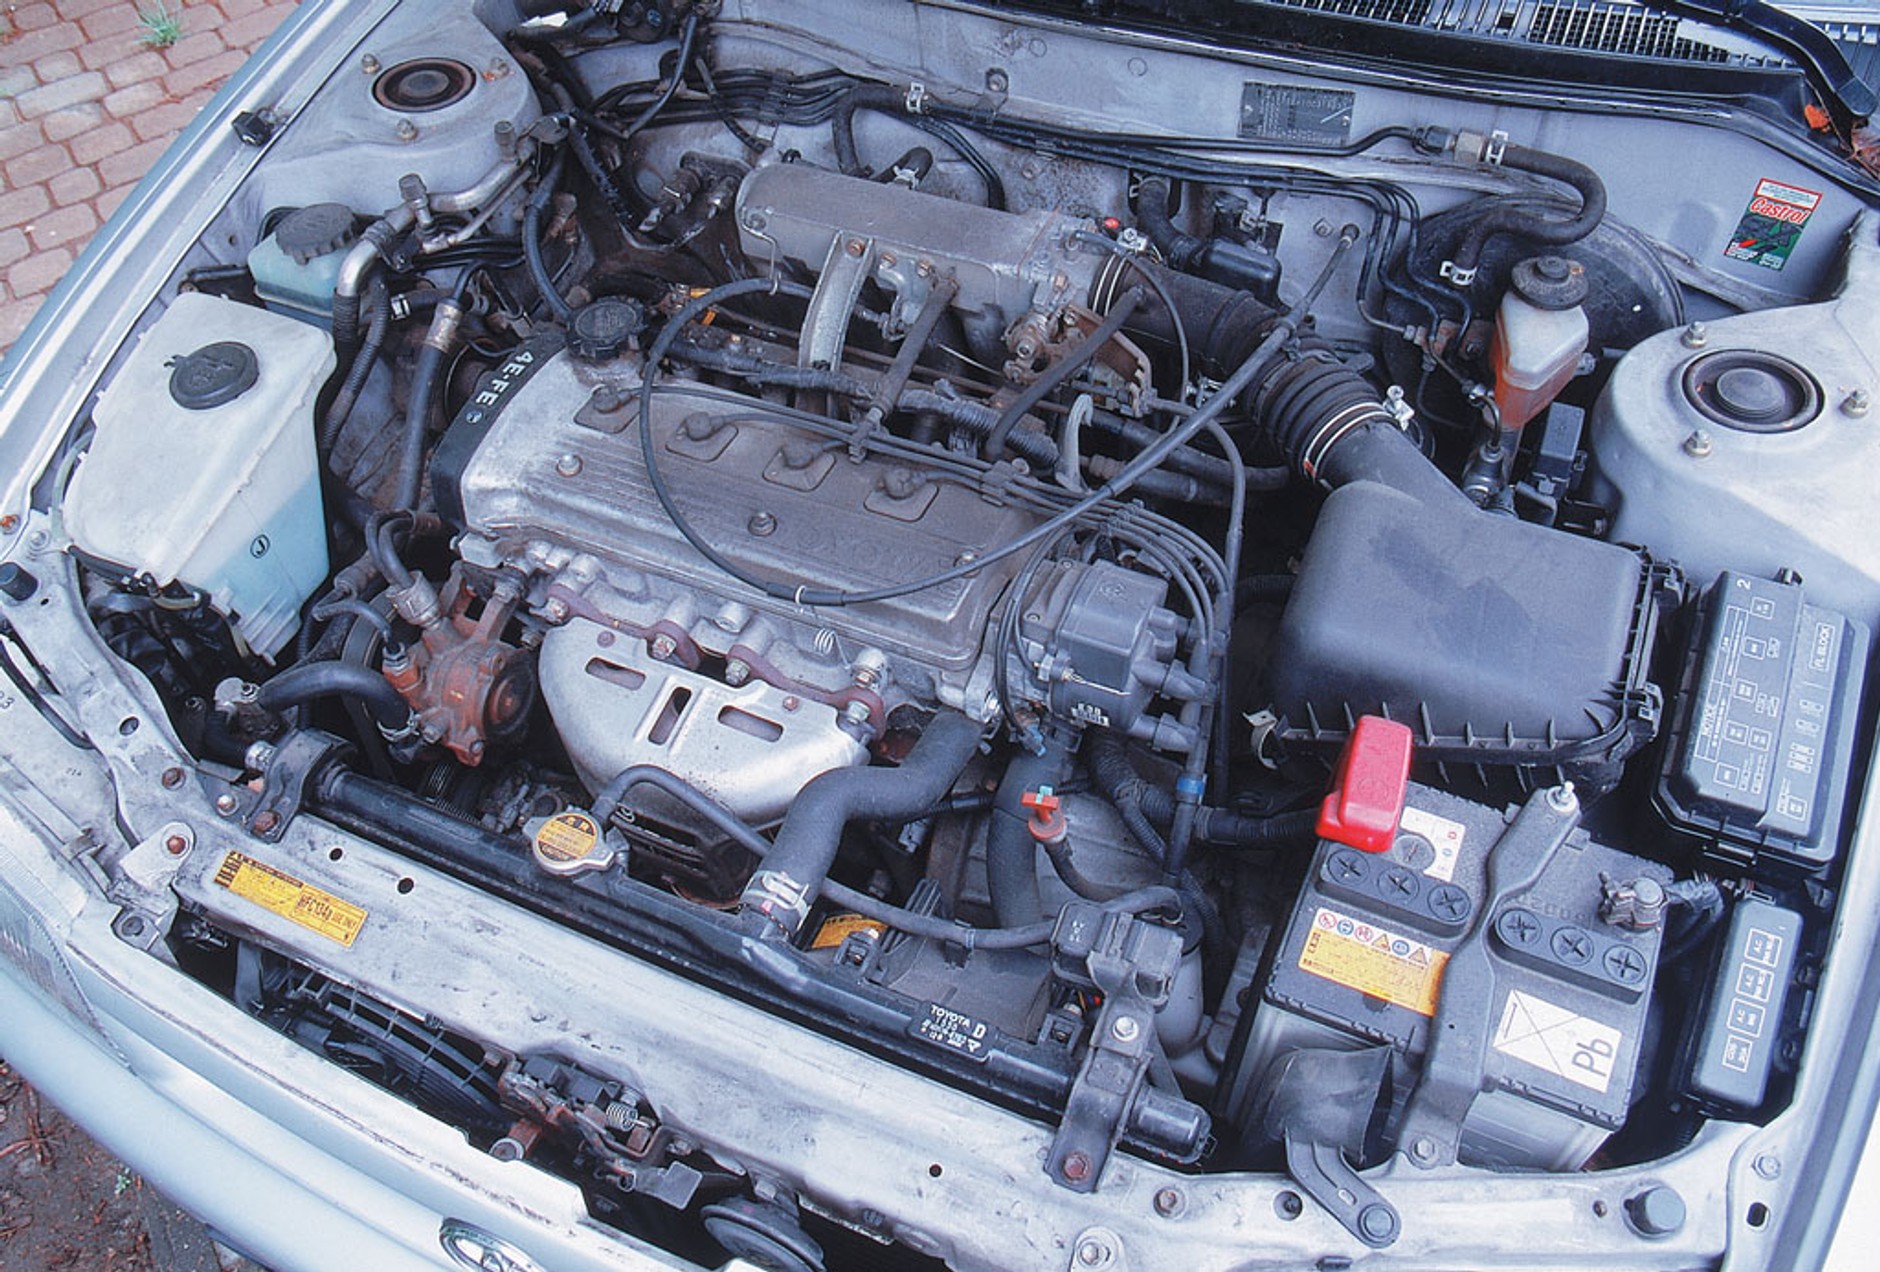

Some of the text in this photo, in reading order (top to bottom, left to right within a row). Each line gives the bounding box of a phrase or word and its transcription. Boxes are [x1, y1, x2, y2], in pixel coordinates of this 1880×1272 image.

[1750, 196, 1811, 225] Castrol
[474, 351, 534, 406] 4E-FE
[1736, 578, 1751, 591] 2
[930, 1004, 971, 1028] TOYOTA
[972, 1022, 987, 1040] D
[1571, 1038, 1615, 1078] Pb
